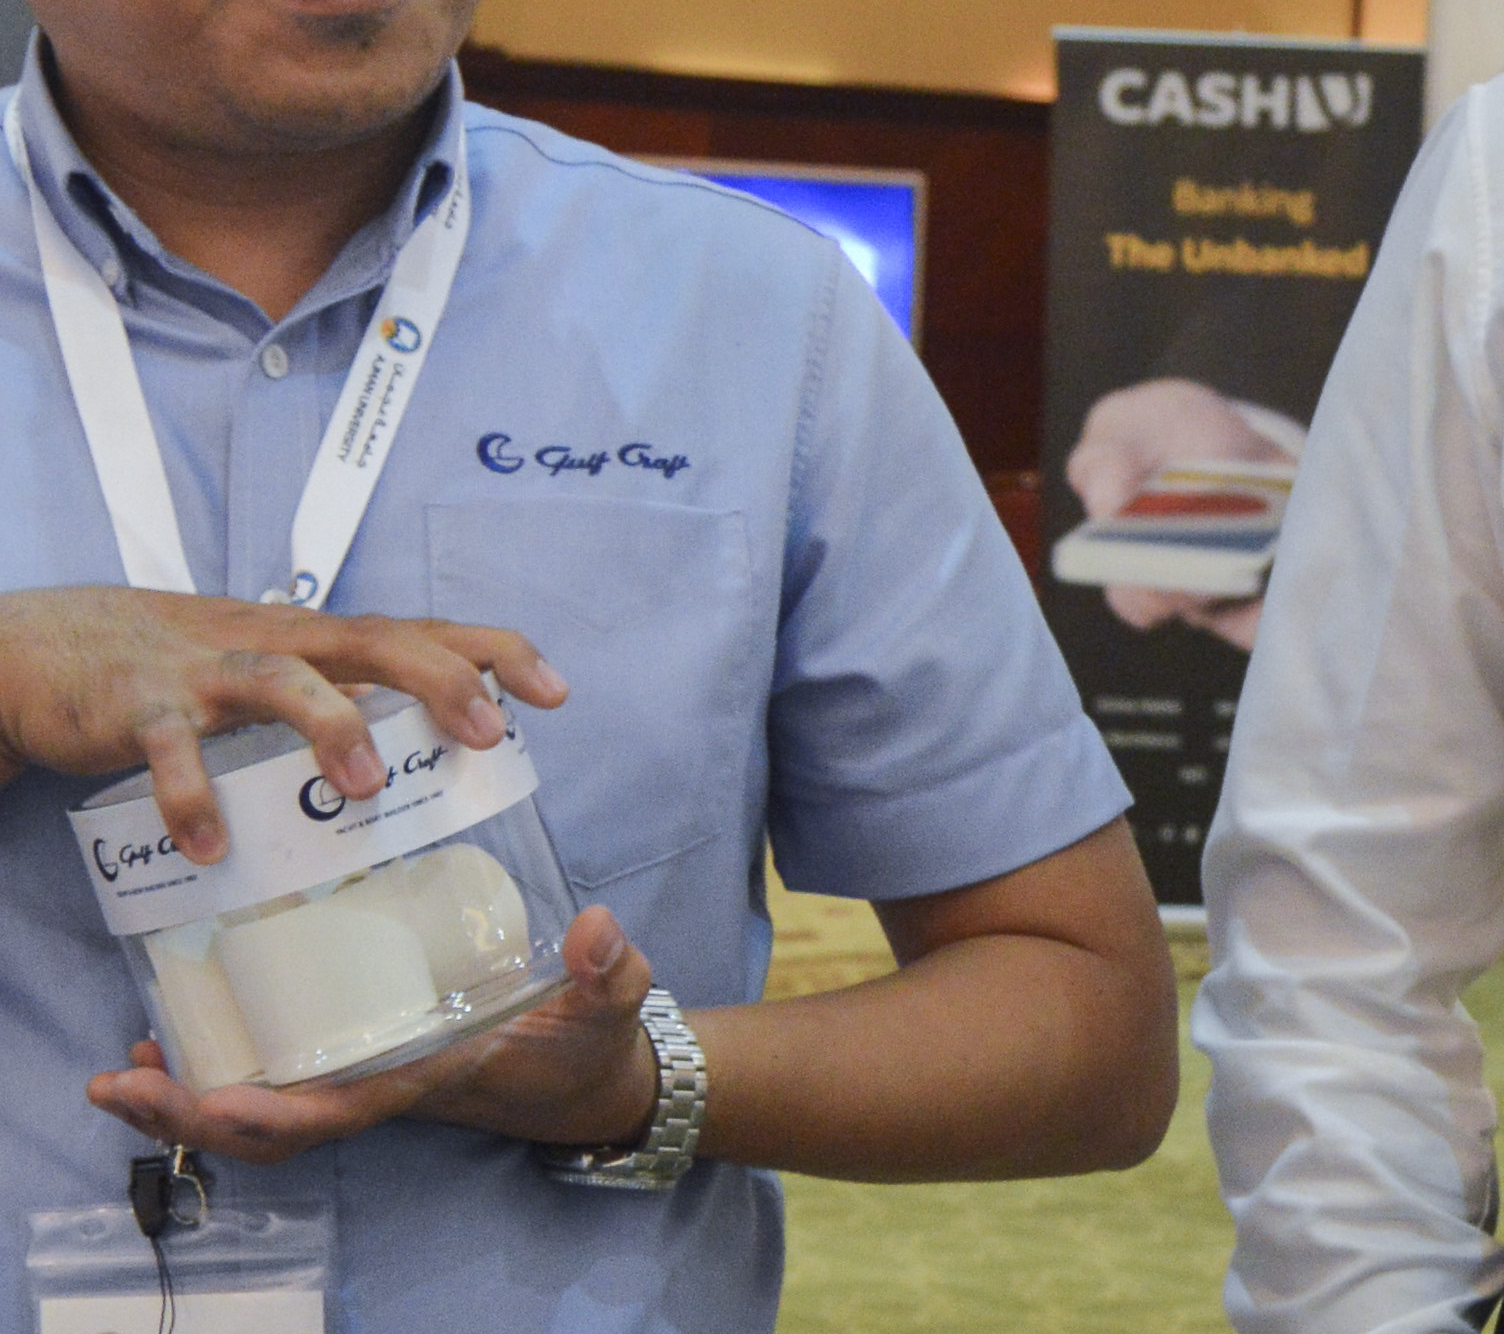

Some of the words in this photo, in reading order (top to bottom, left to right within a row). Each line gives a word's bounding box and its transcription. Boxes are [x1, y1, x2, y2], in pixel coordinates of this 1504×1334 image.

[1172, 177, 1317, 226] Banking
[1106, 231, 1175, 272] The
[1182, 236, 1371, 280] Unbanked
[535, 445, 610, 476] Gulf
[617, 442, 690, 479] Craft
